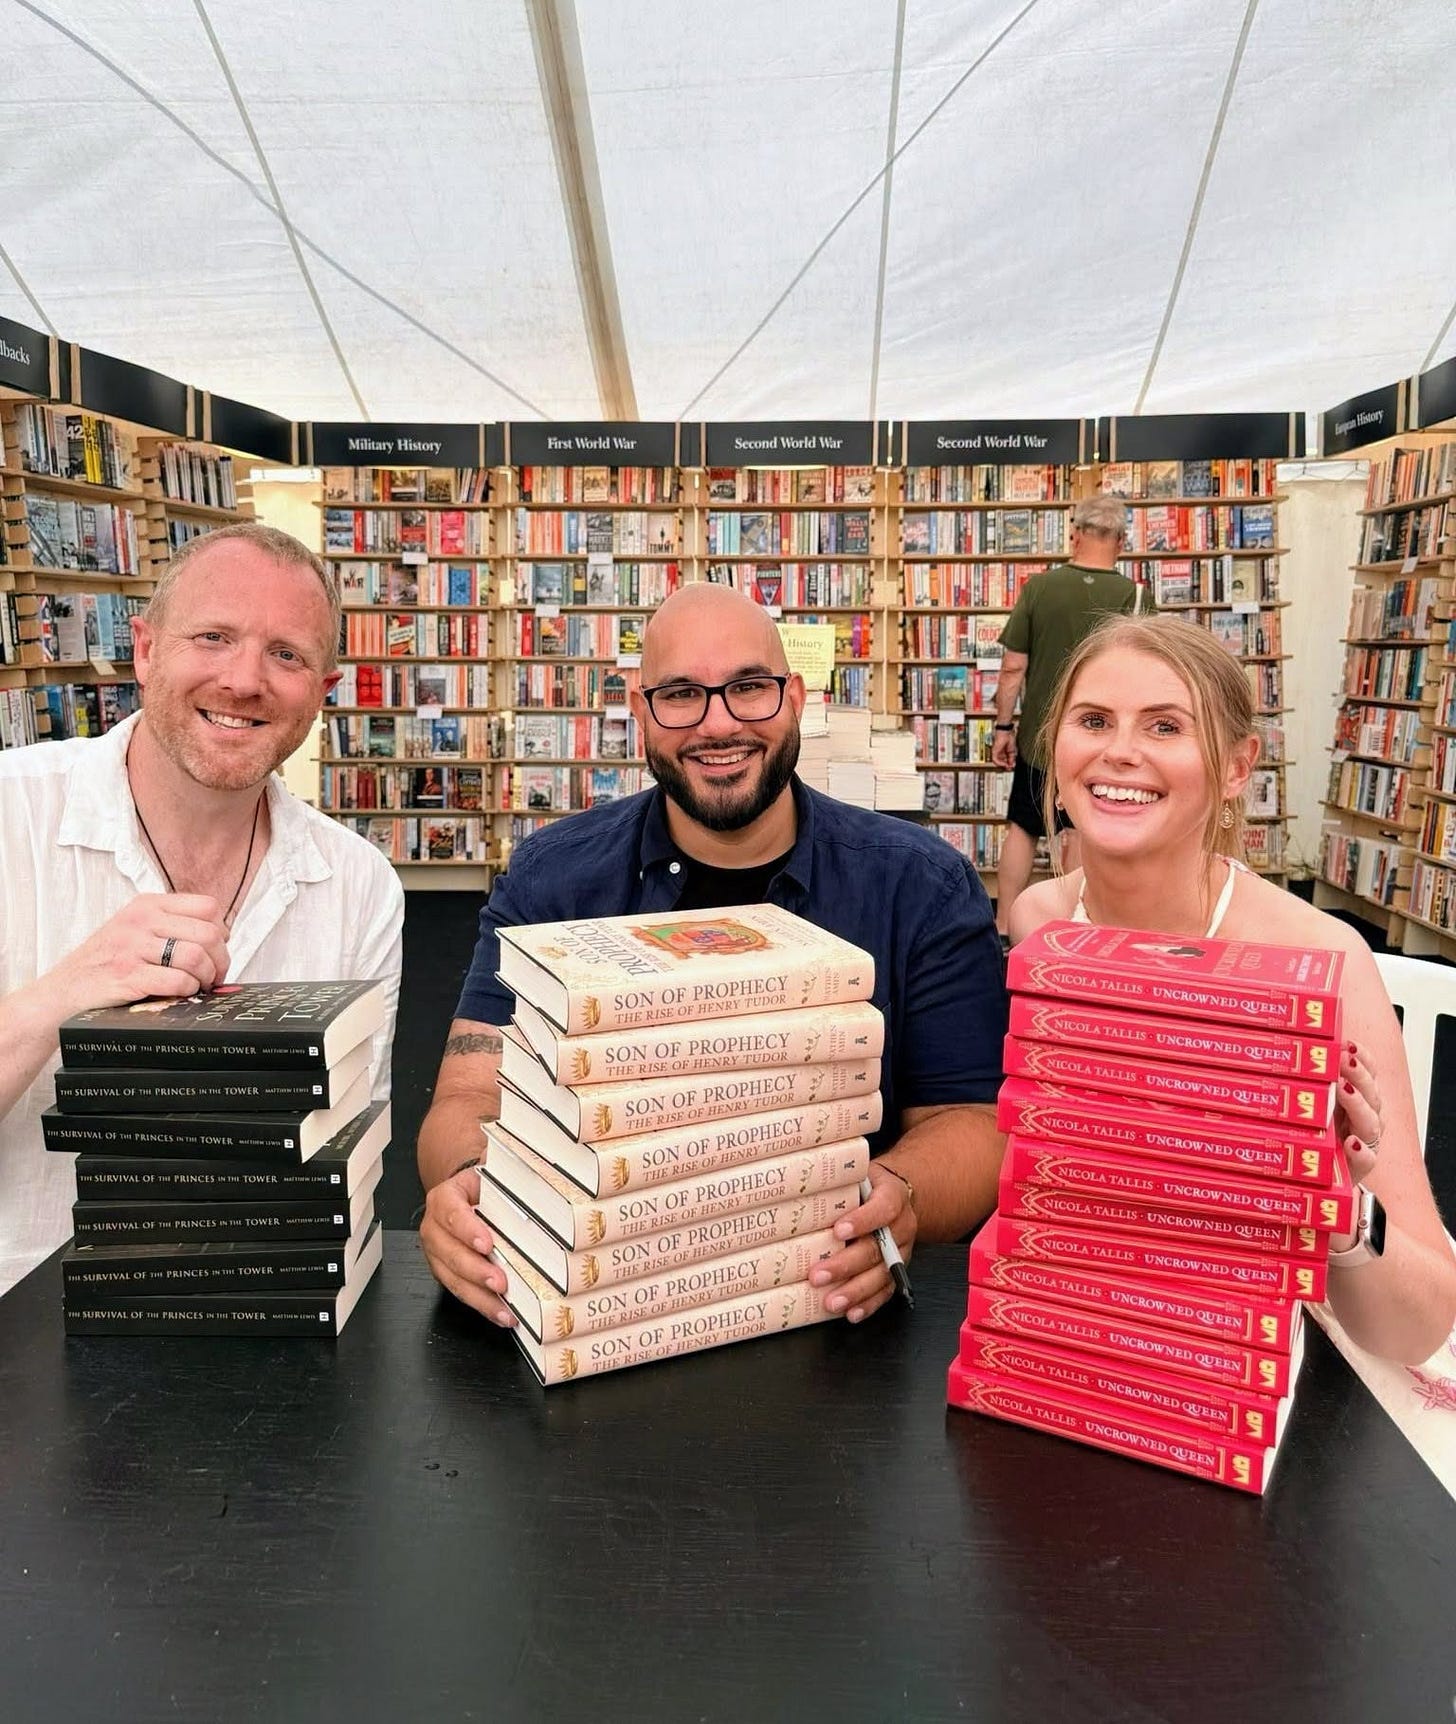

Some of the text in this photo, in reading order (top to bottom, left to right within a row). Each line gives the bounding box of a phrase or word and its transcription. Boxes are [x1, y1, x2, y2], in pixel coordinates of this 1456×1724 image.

[67, 425, 83, 440] 42
[1357, 410, 1383, 426] History
[348, 438, 442, 455] Military History
[547, 437, 638, 450] First World War
[734, 436, 844, 450] Second World War
[936, 435, 1048, 449] Second World War
[650, 544, 674, 554] TOMMY
[343, 576, 364, 589] WAR
[788, 638, 823, 649] History
[561, 924, 659, 976] PROPHECY
[278, 985, 350, 1022] TOWER
[614, 975, 787, 1010] SON OF PROPHECY
[615, 994, 785, 1024] THE RISE OF HENRY TUDOR
[1052, 972, 1287, 1016] NICOLA TALLIS UNCROWNED QUEEN
[605, 1032, 789, 1063] SON OF PROPHECY
[1054, 1018, 1291, 1061] NICOLA TALLIS UNCROWNED QUEEN
[606, 1051, 788, 1076] THE RISE OF HENRY TUDOR
[1047, 1058, 1279, 1105] NICOLA TALLIS UNCROWNED QUEEN
[74, 1088, 119, 1096] SURVIVAL
[154, 1087, 195, 1095] PRINCES
[625, 1074, 795, 1116] SON OF PROPHECY
[642, 1117, 802, 1168] SON OF PROPHECY
[643, 1135, 801, 1181] THE RISE OF HENRY TUDOR
[1042, 1116, 1282, 1164] NICOLA TALLIS UNCROWNED QUEEN
[174, 1174, 214, 1182] PRINCES
[619, 1167, 785, 1221] SON OF PROPHECY
[1058, 1166, 1301, 1214] NICOLA TALLIS UNCROWNED QUEEN
[620, 1185, 785, 1234] THE RISE OF HENRY TUDOR
[1044, 1198, 1282, 1240] NICOLA TALLIS UNCROWNED QUEEN
[612, 1209, 777, 1265] SON OF PROPHECY
[1042, 1239, 1278, 1283] NICOLA TALLIS UNCROWNED QUEEN
[587, 1260, 758, 1316] SON OF PROPHECY
[588, 1279, 759, 1329] THE RISE OF HENRY TUDOR
[1012, 1270, 1242, 1328] NICOLA TALLIS UNCROWNED QUEEN
[591, 1303, 765, 1359] SON OF PROPHECY
[592, 1321, 766, 1372] THE RISE OF HENRY TUDOR
[1010, 1311, 1241, 1372] NICOLA TALLIS UNCROWNED QUEEN
[1000, 1354, 1228, 1421] NICOLA TALLIS UNCROWNED QUEEN
[990, 1395, 1215, 1467] NICOLA TALLIS UNCROWNED QUEEN
